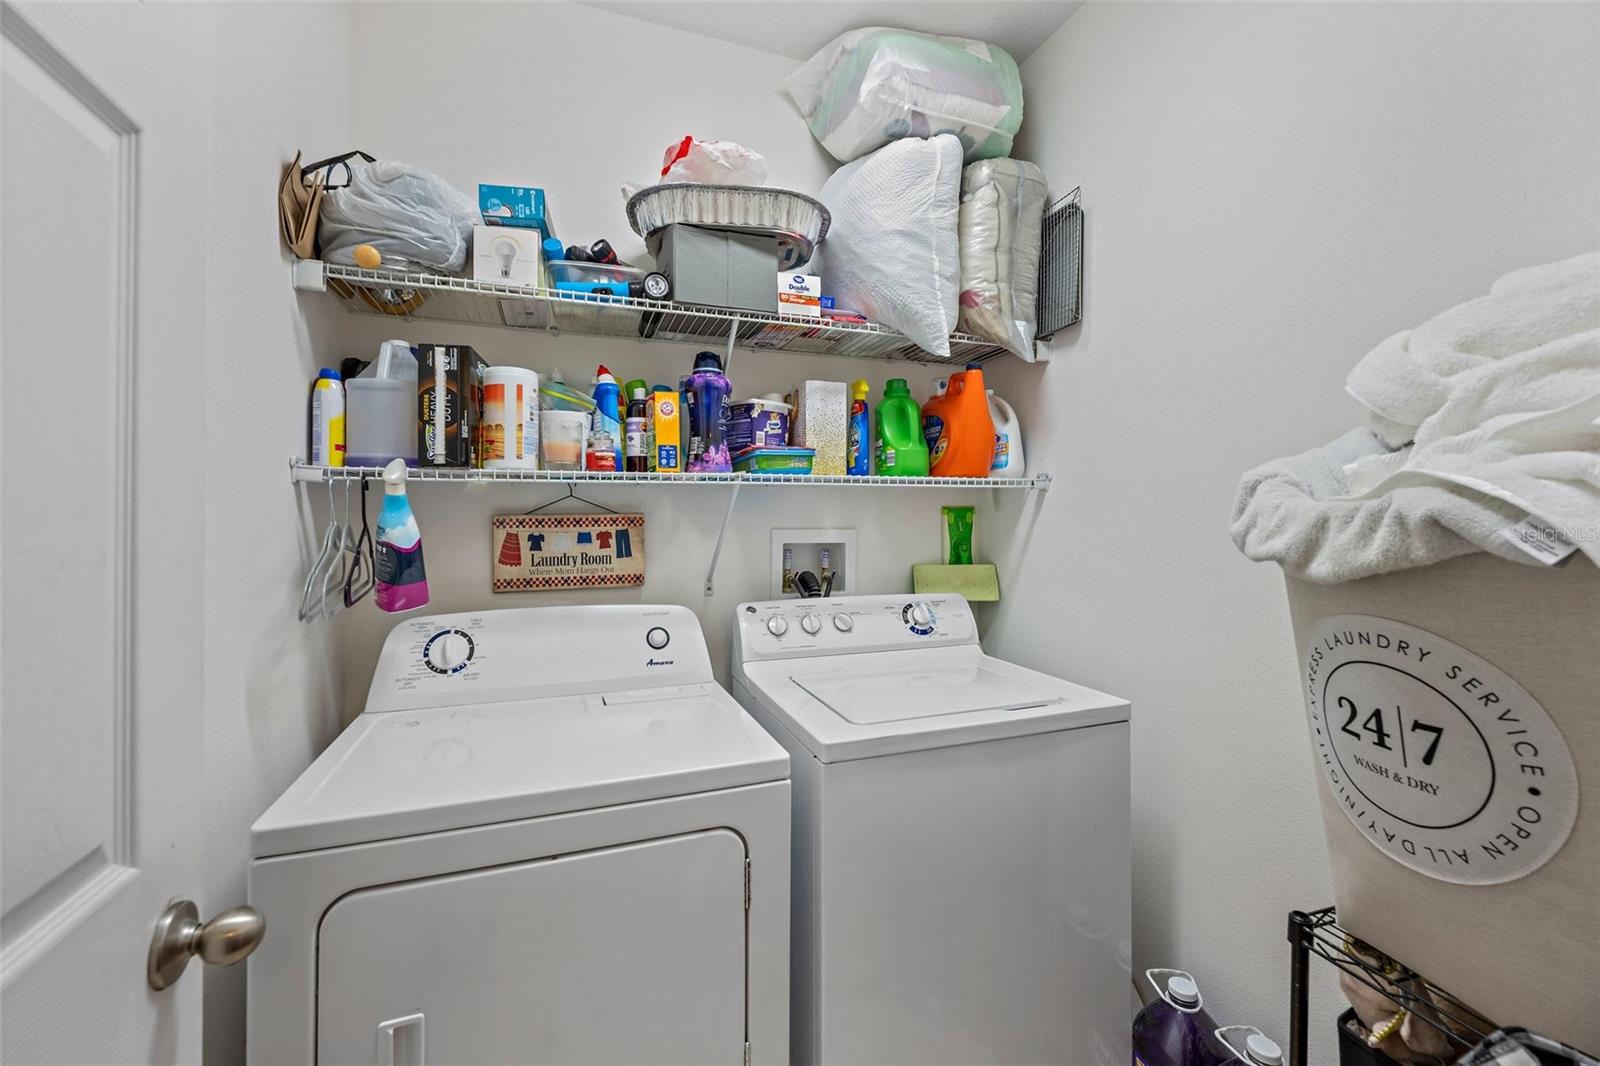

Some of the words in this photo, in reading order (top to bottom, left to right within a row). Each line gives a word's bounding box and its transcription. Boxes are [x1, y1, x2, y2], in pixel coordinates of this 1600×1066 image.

[788, 284, 810, 292] Double
[531, 552, 578, 567] Laundry
[580, 552, 612, 566] Room
[528, 568, 554, 576] Where
[555, 567, 574, 575] Mom
[576, 567, 599, 575] Hangs
[647, 659, 674, 667] Amana
[1325, 631, 1431, 662] LAUNDRY
[1445, 665, 1545, 778] SERVICE
[1353, 754, 1390, 779] WASH
[1393, 772, 1404, 784] &
[1407, 776, 1440, 796] DRY
[1481, 805, 1542, 860] OPEN
